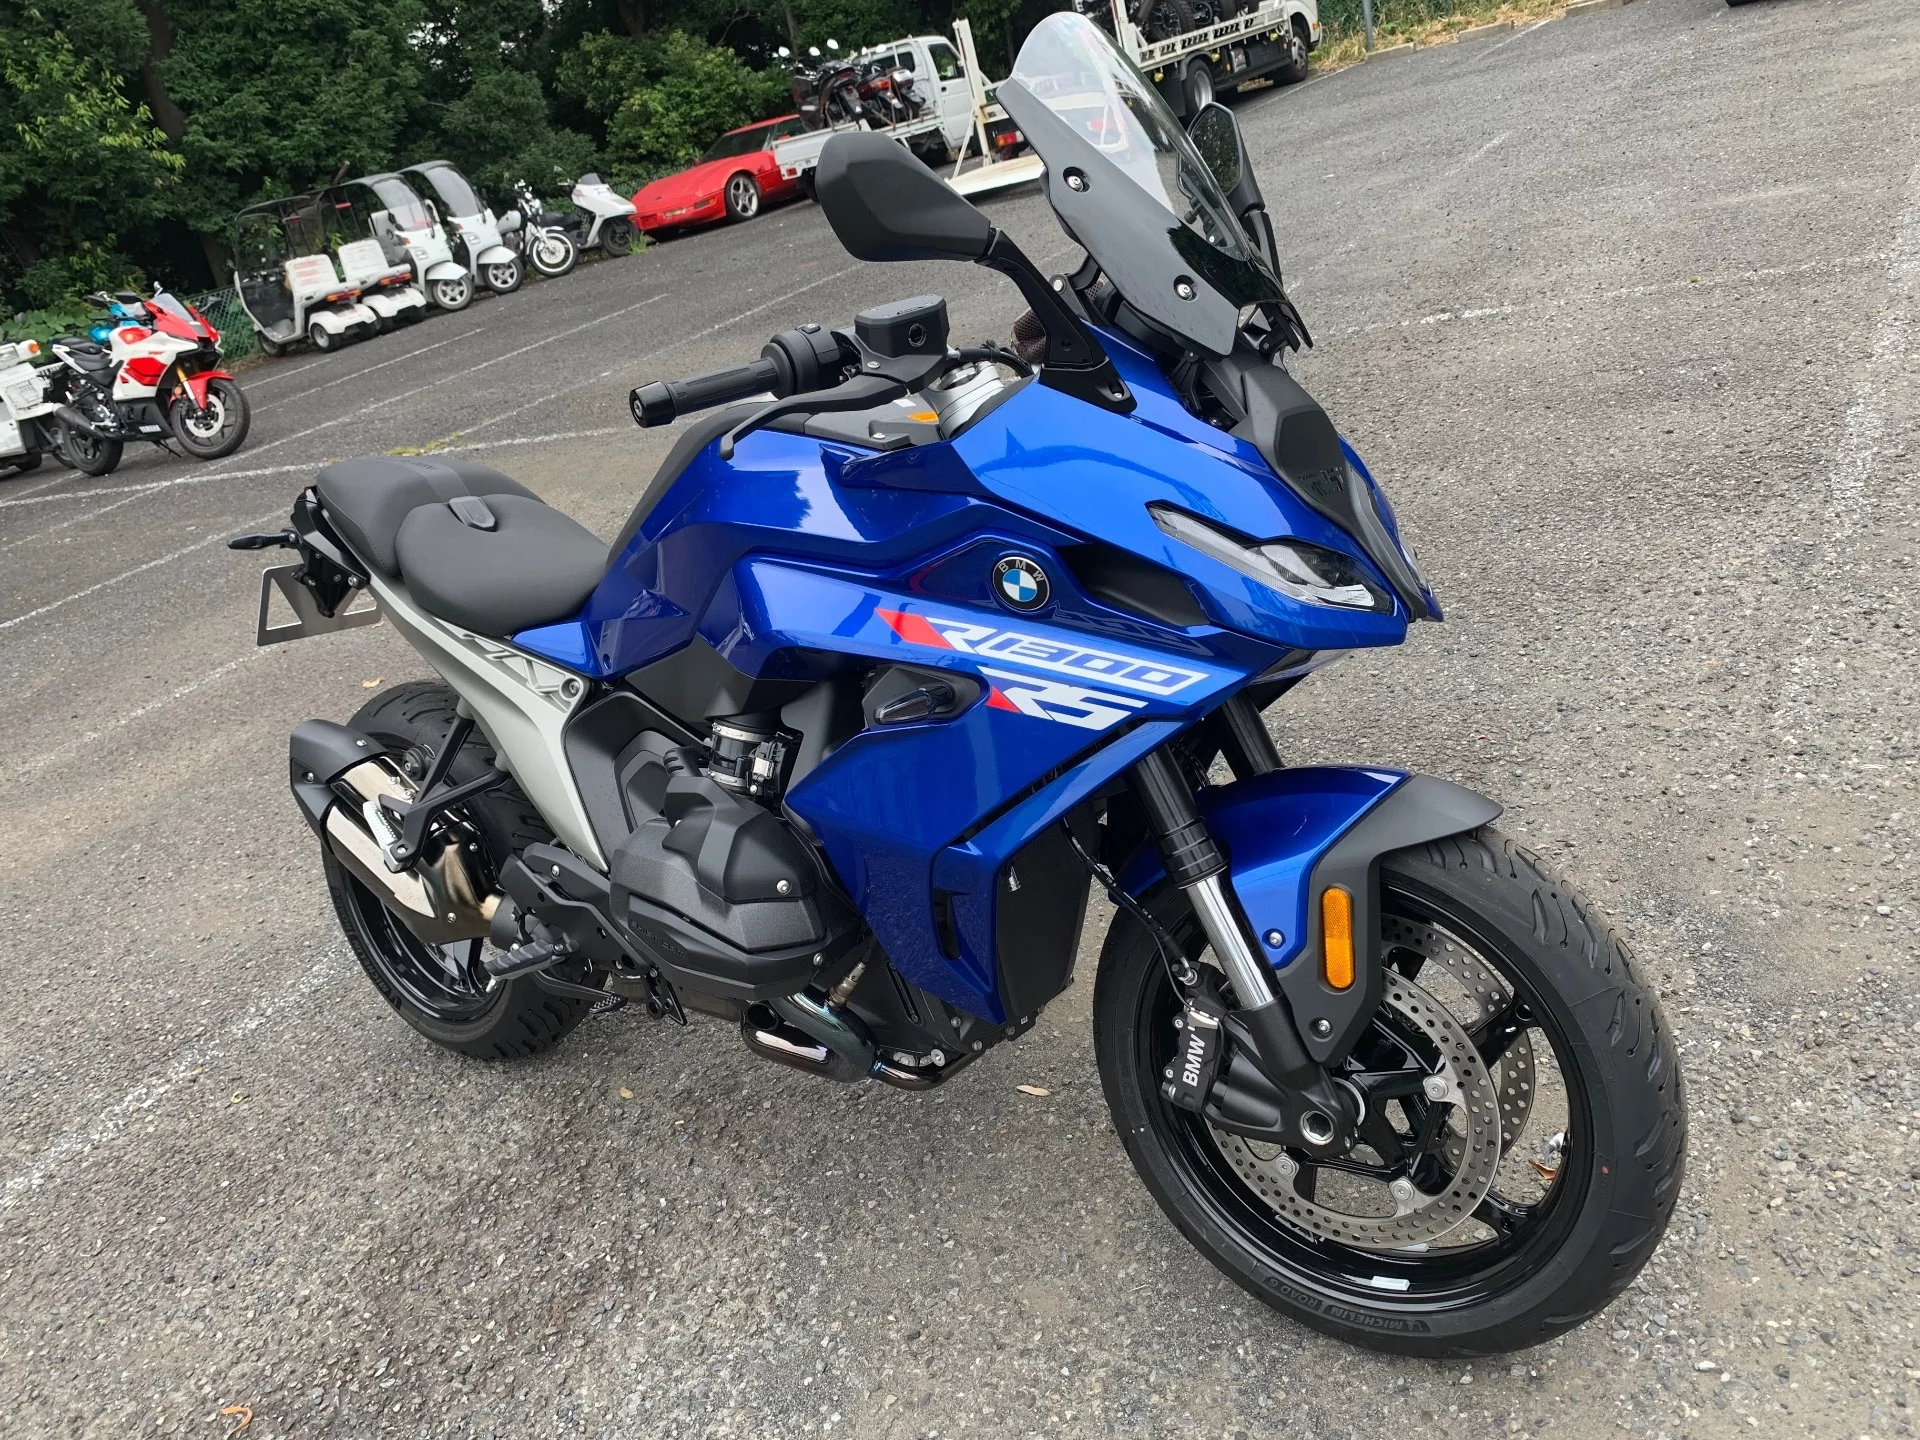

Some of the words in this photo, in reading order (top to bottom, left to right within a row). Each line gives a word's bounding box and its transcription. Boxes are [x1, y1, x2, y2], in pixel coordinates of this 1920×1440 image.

[997, 559, 1045, 582] BMW
[925, 616, 1210, 696] R1300
[976, 665, 1149, 730] RS
[1182, 1033, 1205, 1087] BMW
[1280, 1285, 1319, 1308] ROAD
[1330, 1306, 1404, 1330] MICHELIN
